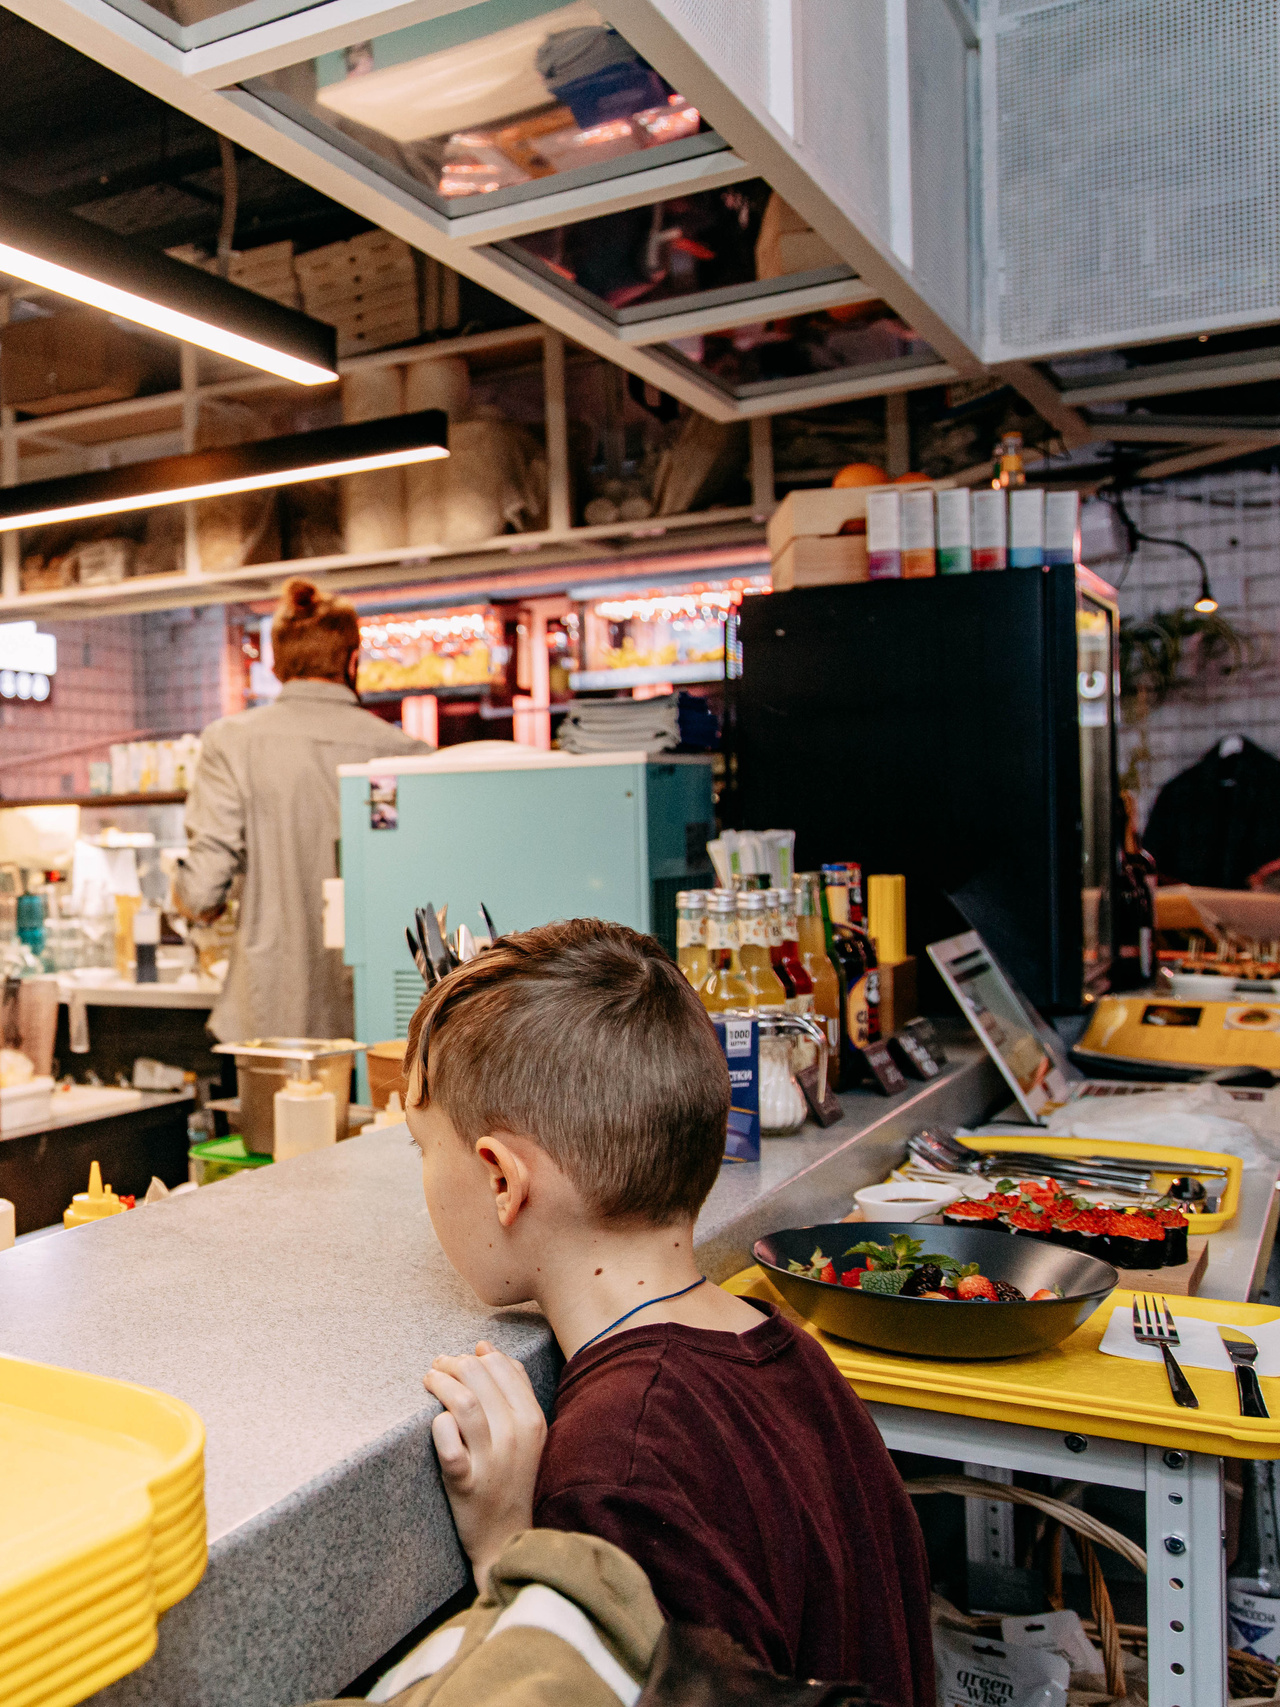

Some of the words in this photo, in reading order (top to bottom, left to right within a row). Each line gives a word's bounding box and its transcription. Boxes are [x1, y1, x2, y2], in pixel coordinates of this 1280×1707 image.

[729, 1028, 751, 1039] 1000
[956, 1669, 1014, 1700] green
[966, 1684, 1008, 1707] wise
